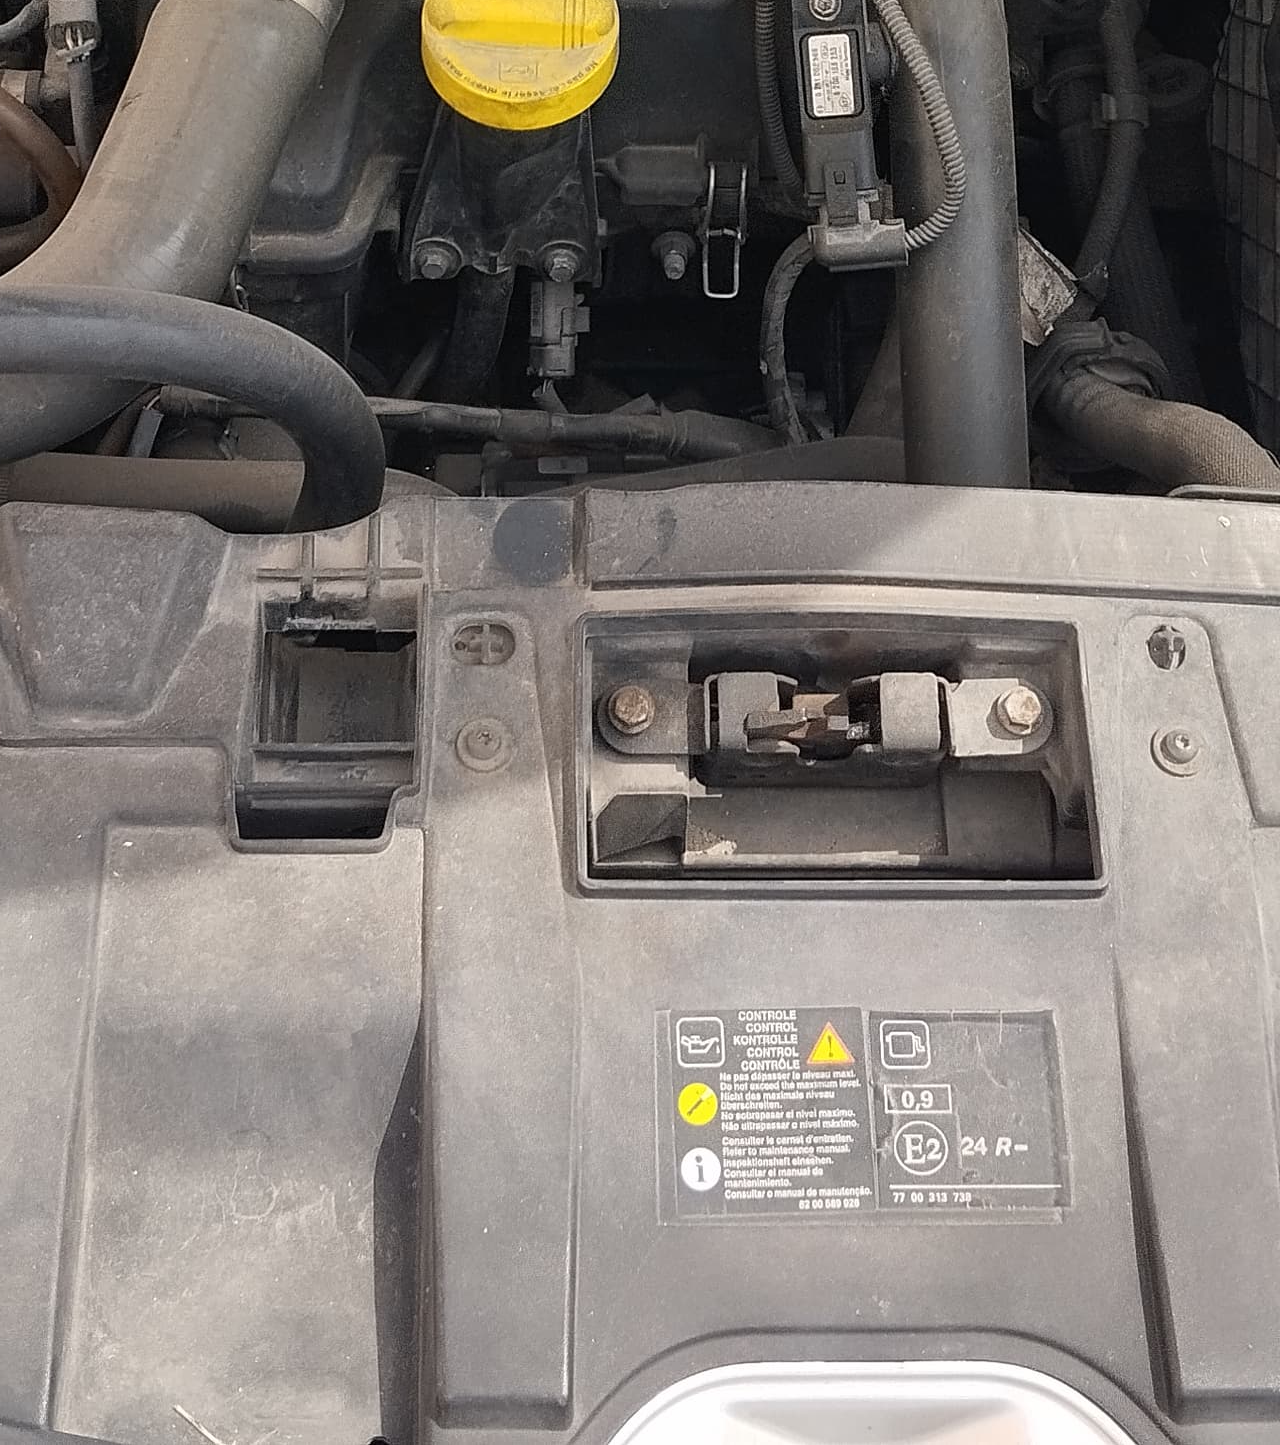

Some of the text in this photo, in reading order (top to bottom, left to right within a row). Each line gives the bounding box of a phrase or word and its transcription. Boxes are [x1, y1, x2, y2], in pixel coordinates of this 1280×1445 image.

[738, 1010, 797, 1020] CONTROLE
[746, 1022, 798, 1032] CONTROL
[733, 1034, 798, 1046] KONTROLLE
[746, 1046, 799, 1058] CONTROL
[741, 1055, 801, 1071] CONTRÔLE
[734, 1074, 749, 1083] pas
[750, 1072, 790, 1082] dépasser
[792, 1071, 800, 1080] le
[802, 1070, 830, 1079] niveau
[833, 1070, 856, 1078] maxi.
[720, 1079, 861, 1091] Do not exceed the maximum level.
[720, 1092, 744, 1101] Nicht
[763, 1090, 804, 1101] maximale
[901, 1090, 934, 1111] 0,9
[721, 1112, 734, 1120] No
[786, 1110, 794, 1118] el
[796, 1108, 817, 1118] nivel
[722, 1120, 740, 1131] Não
[741, 1120, 790, 1132] ultrapassar
[722, 1136, 765, 1146] Consulter
[766, 1136, 775, 1145] le
[776, 1135, 804, 1144] carnet
[960, 1136, 988, 1156] 24
[722, 1144, 850, 1156] Refer to maintenance manual.
[902, 1134, 942, 1164] E2
[792, 1156, 834, 1166] einsehen.
[724, 1166, 824, 1178] Consultar el manual de
[724, 1178, 792, 1188] mantenimiento.
[724, 1189, 766, 1199] Consultar
[774, 1188, 804, 1198] manual
[806, 1187, 818, 1196] de
[818, 1186, 872, 1197] manutenção.
[892, 1192, 905, 1202] 77
[910, 1192, 924, 1202] 00
[928, 1192, 948, 1202] 313
[812, 1199, 824, 1209] 00
